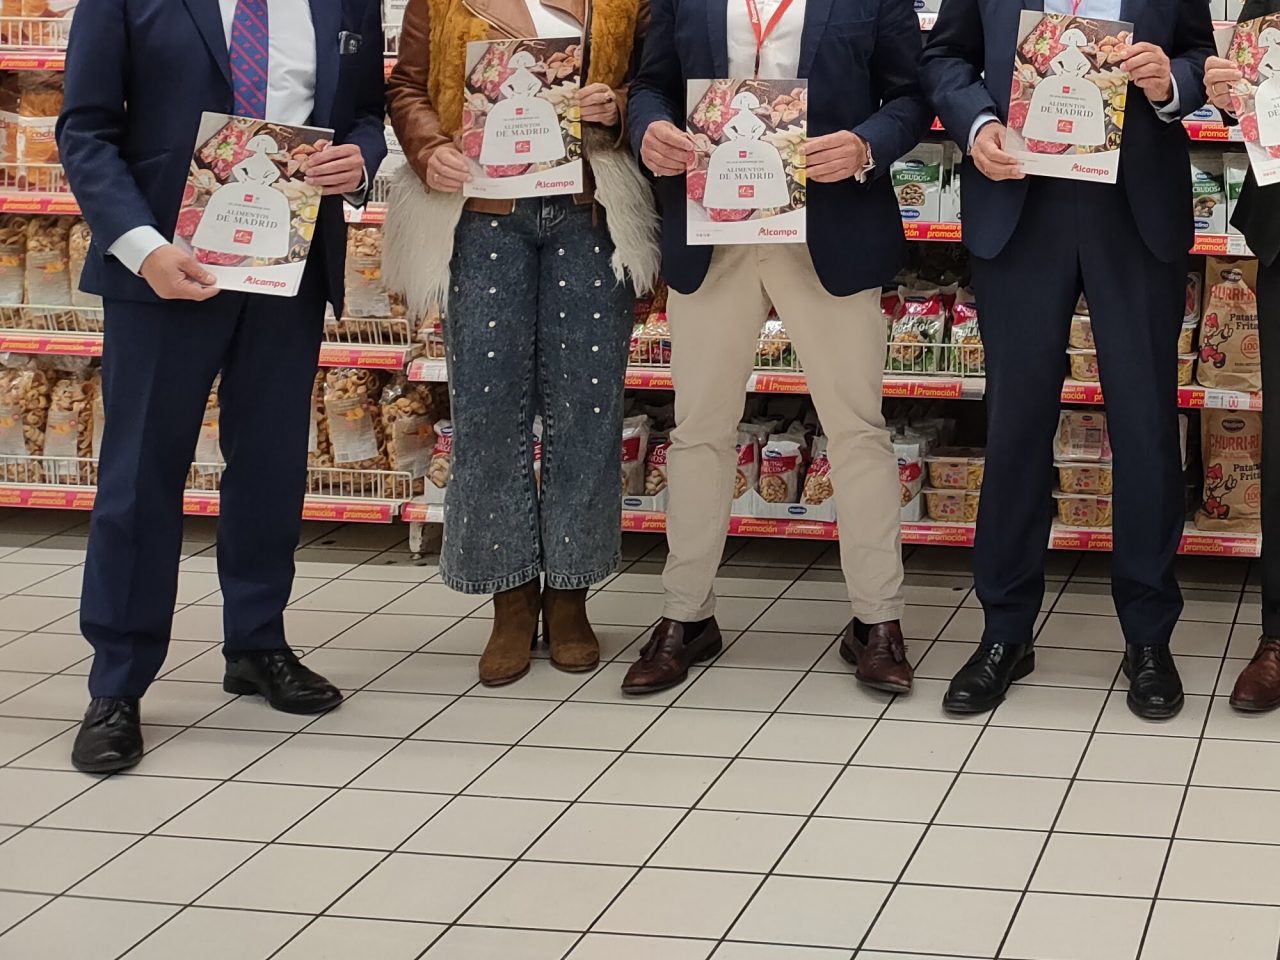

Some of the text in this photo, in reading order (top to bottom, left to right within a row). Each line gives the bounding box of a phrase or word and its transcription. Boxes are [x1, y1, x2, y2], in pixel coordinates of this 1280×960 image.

[1056, 107, 1094, 118] MADRID
[512, 127, 550, 136] MADRID
[1071, 163, 1109, 176] Alcampo
[734, 172, 774, 180] MADRID
[535, 180, 574, 189] Alcampo
[234, 215, 278, 229] MADRID
[758, 227, 798, 237] Alcampo
[243, 275, 287, 288] Alcampo
[738, 525, 778, 534] promoción
[927, 534, 967, 542] promoción
